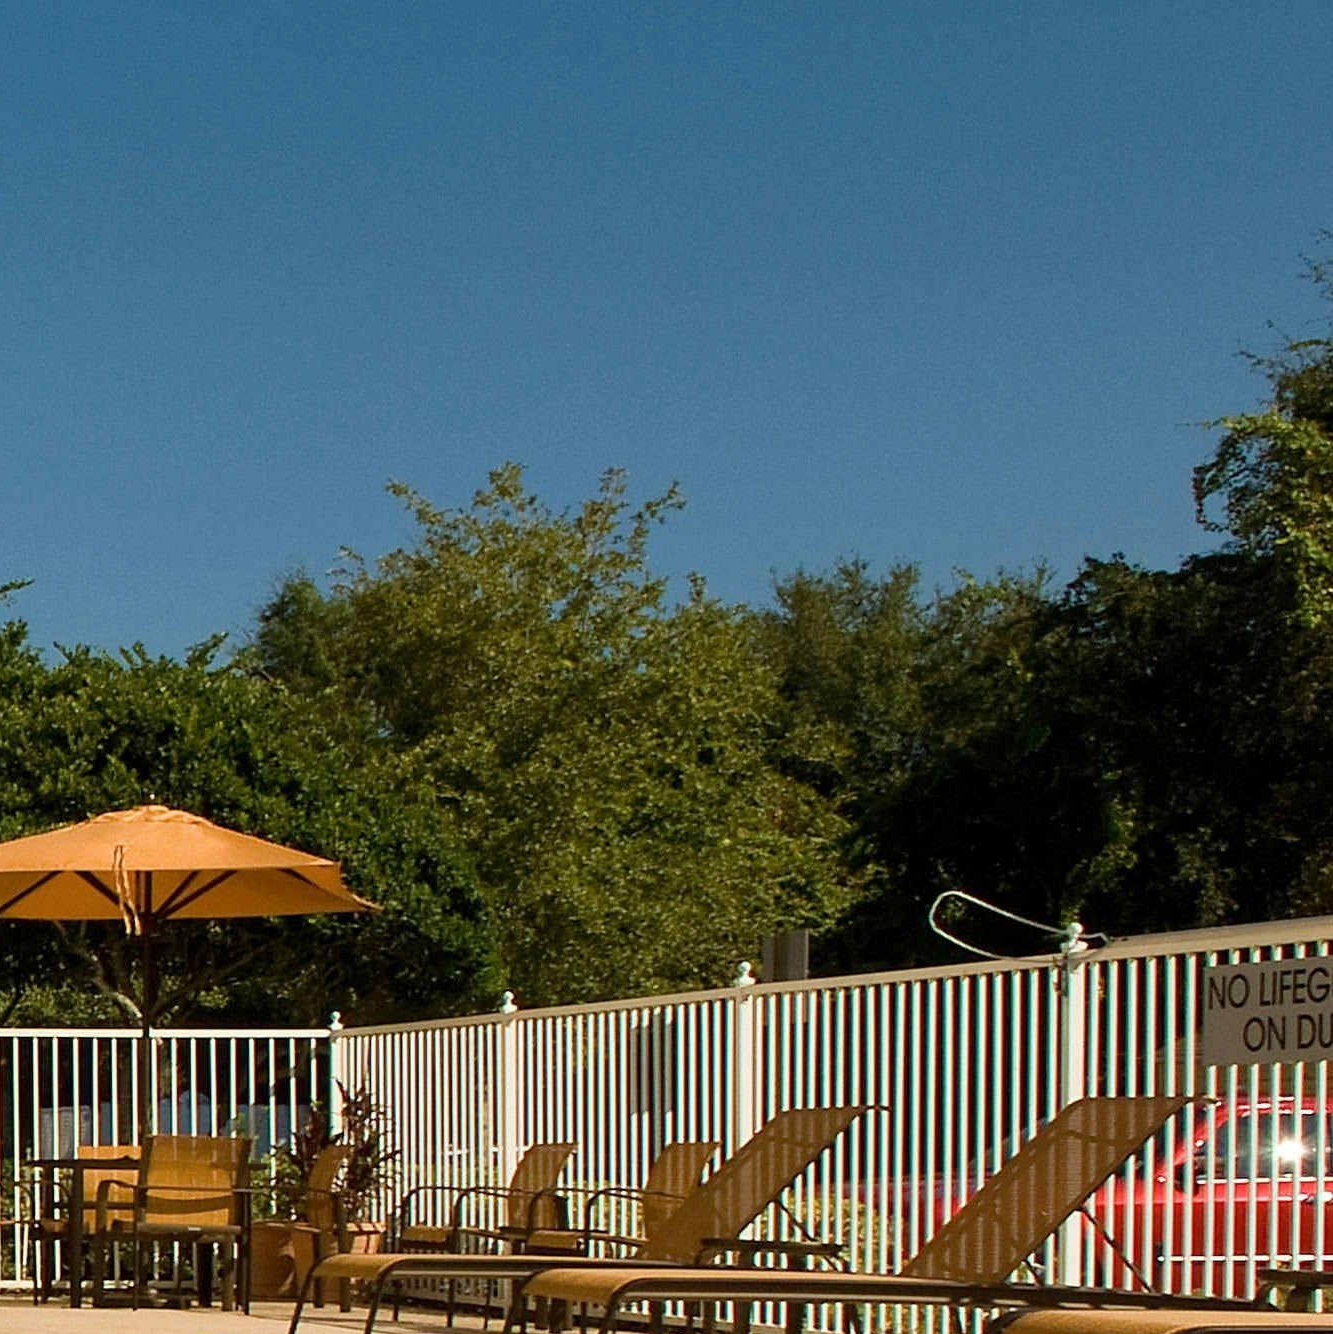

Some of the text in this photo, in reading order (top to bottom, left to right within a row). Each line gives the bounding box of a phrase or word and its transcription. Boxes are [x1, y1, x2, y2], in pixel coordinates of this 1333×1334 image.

[1208, 967, 1333, 1010] NO LIFEG
[1243, 1016, 1286, 1052] ON
